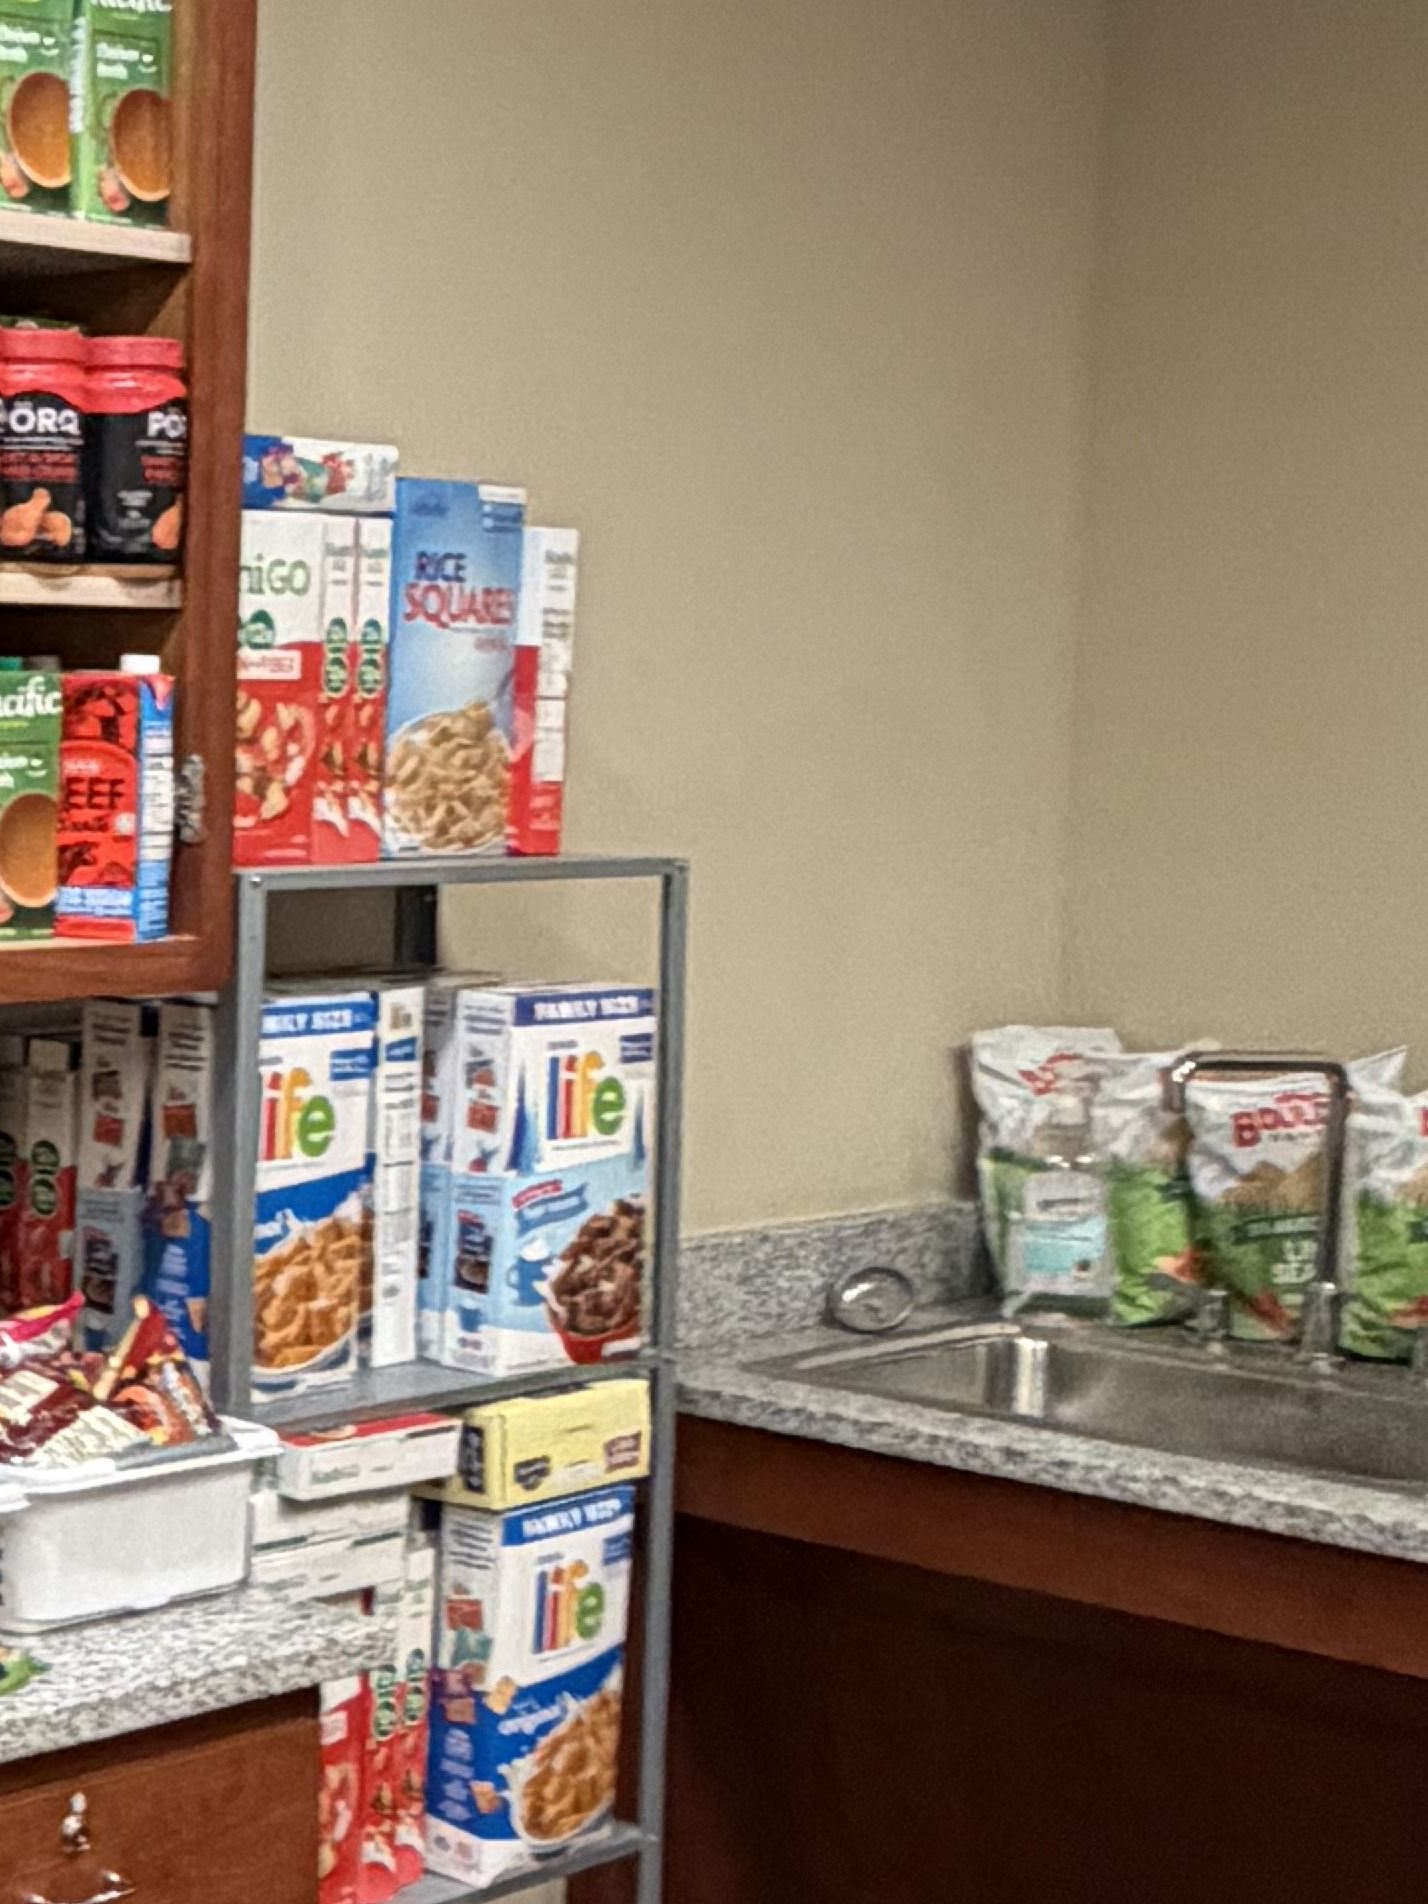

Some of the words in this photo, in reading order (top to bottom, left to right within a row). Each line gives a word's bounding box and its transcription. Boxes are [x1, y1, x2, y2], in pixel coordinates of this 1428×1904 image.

[415, 550, 467, 583] RICE
[65, 775, 126, 810] EEF
[258, 1066, 336, 1162] ife
